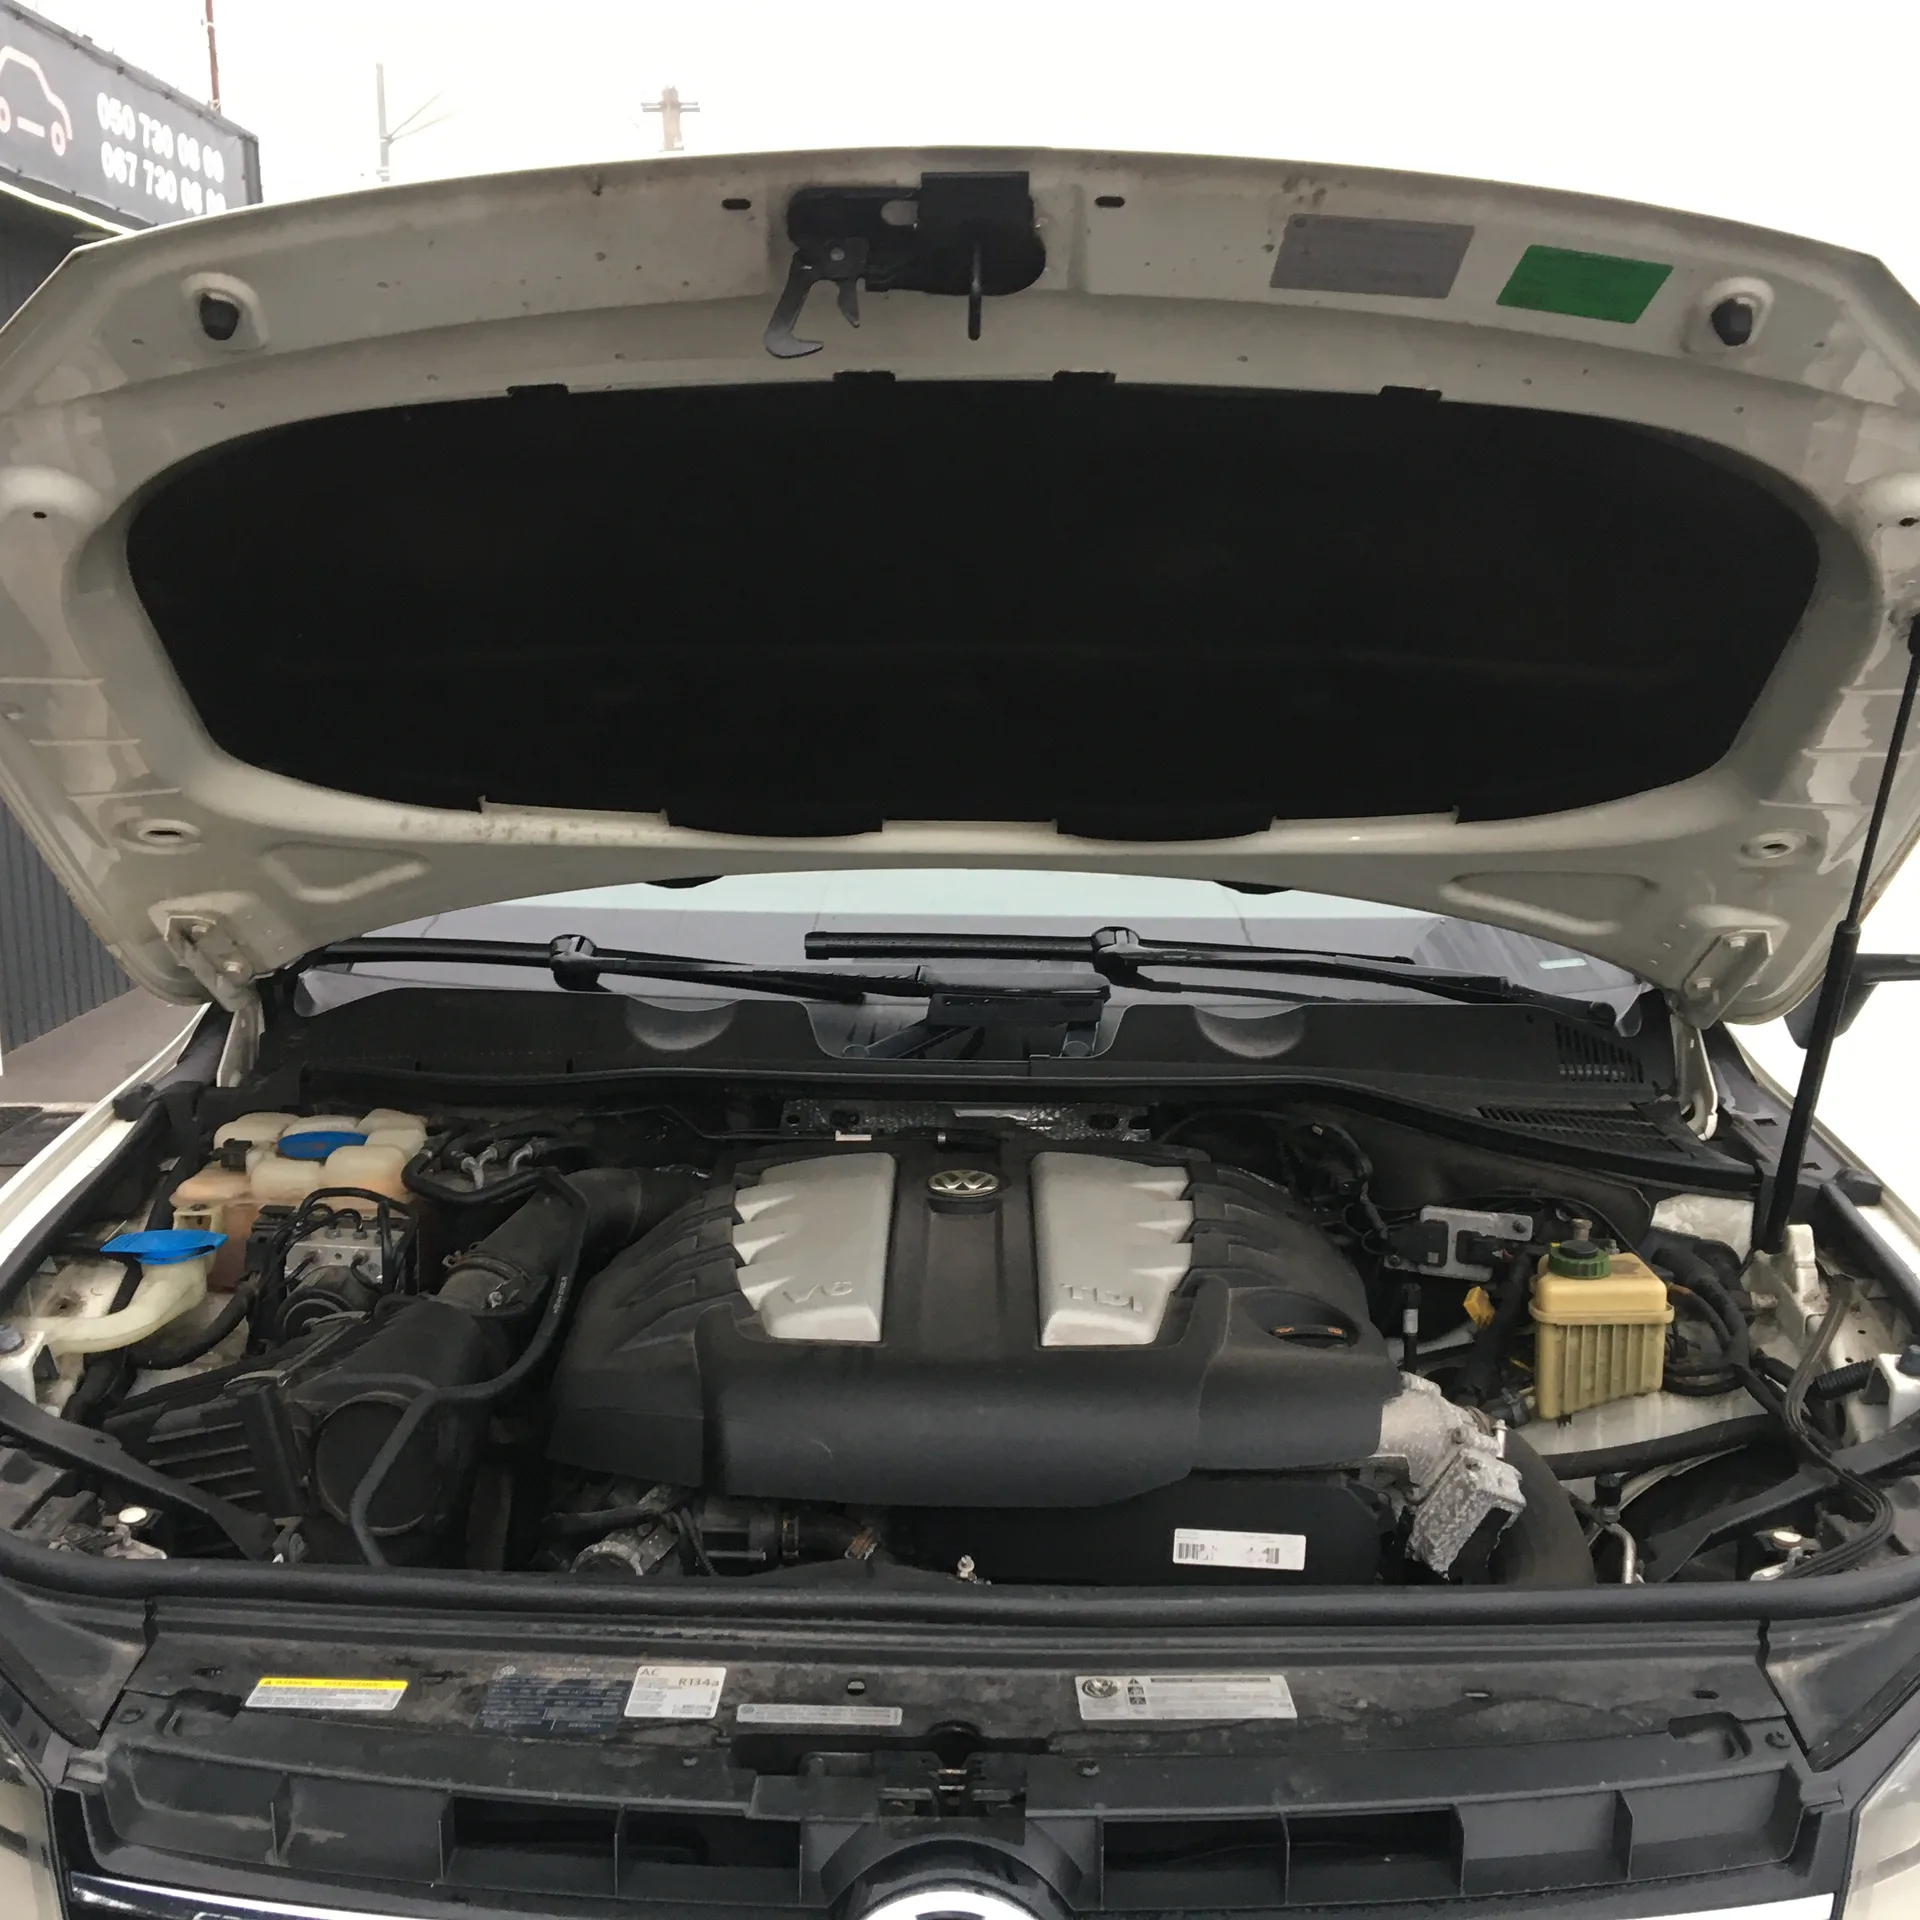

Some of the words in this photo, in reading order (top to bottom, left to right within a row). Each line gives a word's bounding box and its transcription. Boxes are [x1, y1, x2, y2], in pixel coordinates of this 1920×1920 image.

[97, 92, 136, 141] 050
[782, 1281, 853, 1304] V6
[1060, 1283, 1144, 1313] TDI
[640, 1667, 661, 1677] AC
[678, 1677, 720, 1687] R134a
